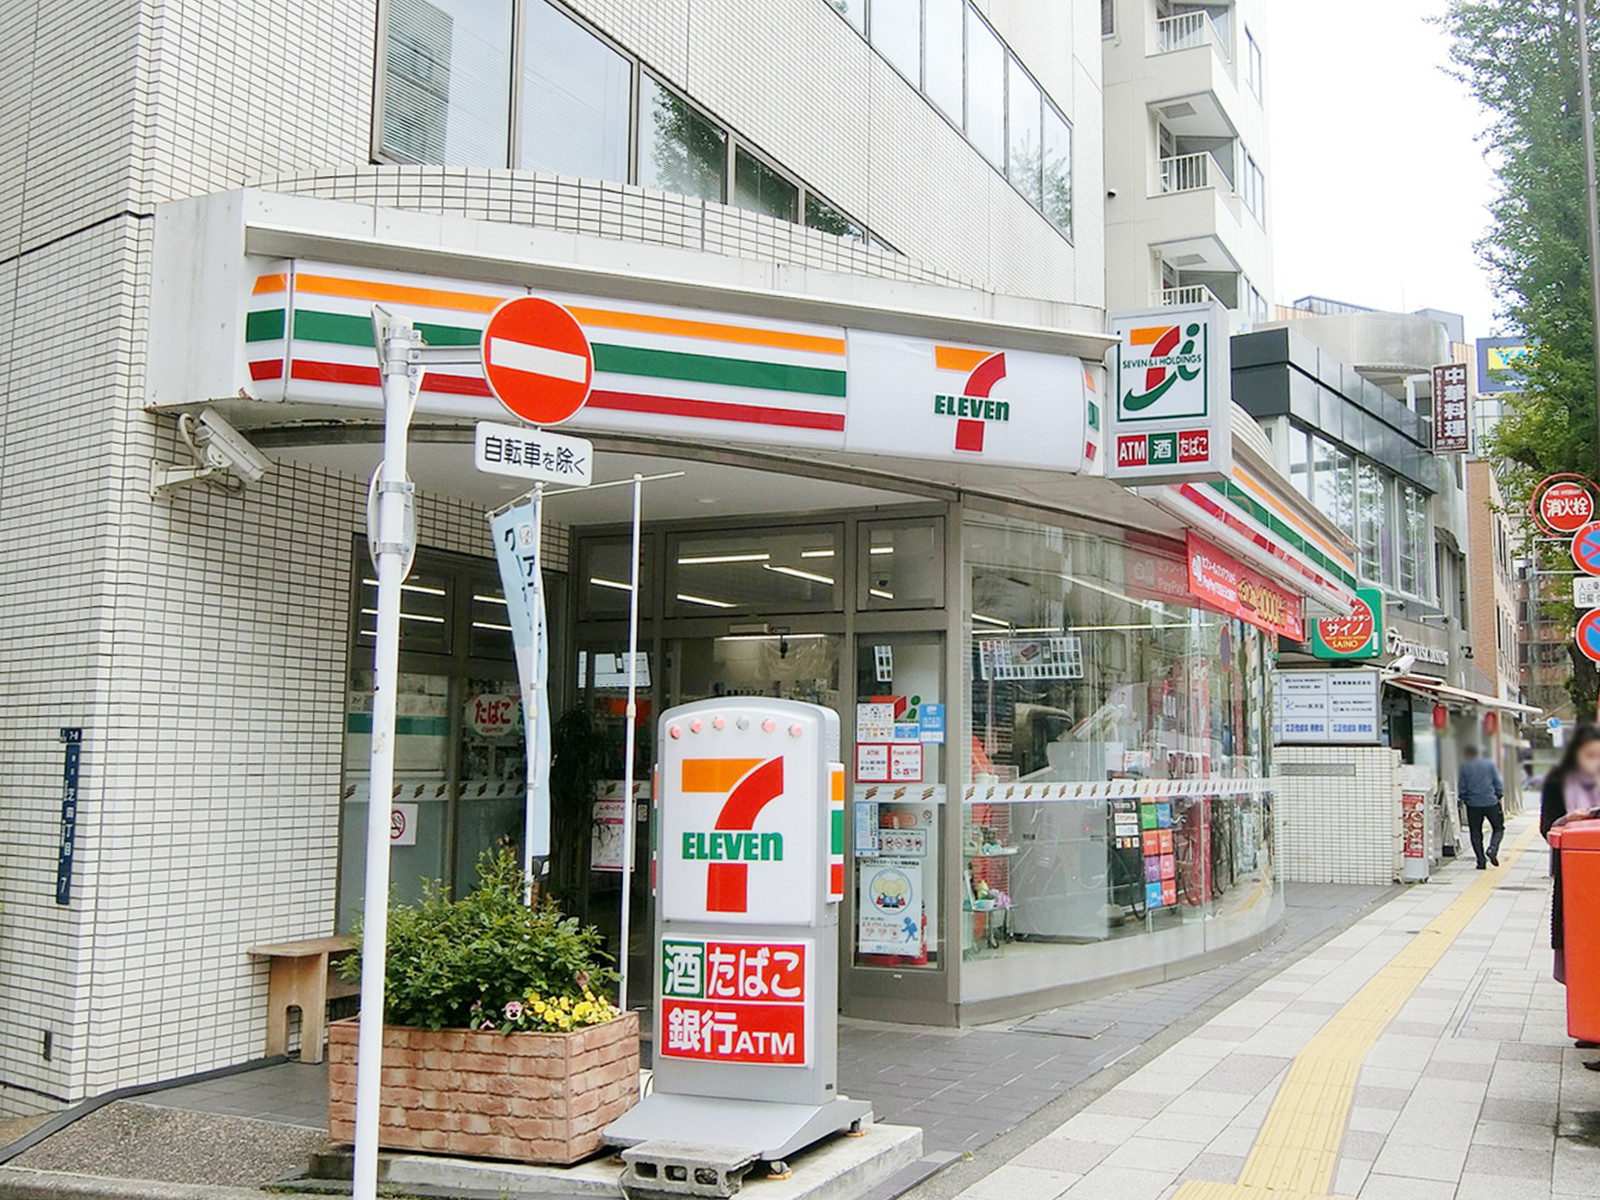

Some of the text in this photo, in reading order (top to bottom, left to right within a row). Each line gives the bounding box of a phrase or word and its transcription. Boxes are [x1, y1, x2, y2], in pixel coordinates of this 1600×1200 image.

[1159, 354, 1202, 367] HOLDINGS
[1444, 367, 1466, 437] 中華料理
[484, 435, 586, 476] 自転車を除く
[1119, 436, 1208, 461] ATM 酒 たばこ
[1546, 496, 1589, 518] 消火栓
[1326, 622, 1364, 636] サイノ
[1332, 640, 1359, 649] SAINO
[475, 700, 512, 725] たばこ
[665, 945, 801, 998] 酒 たばこ
